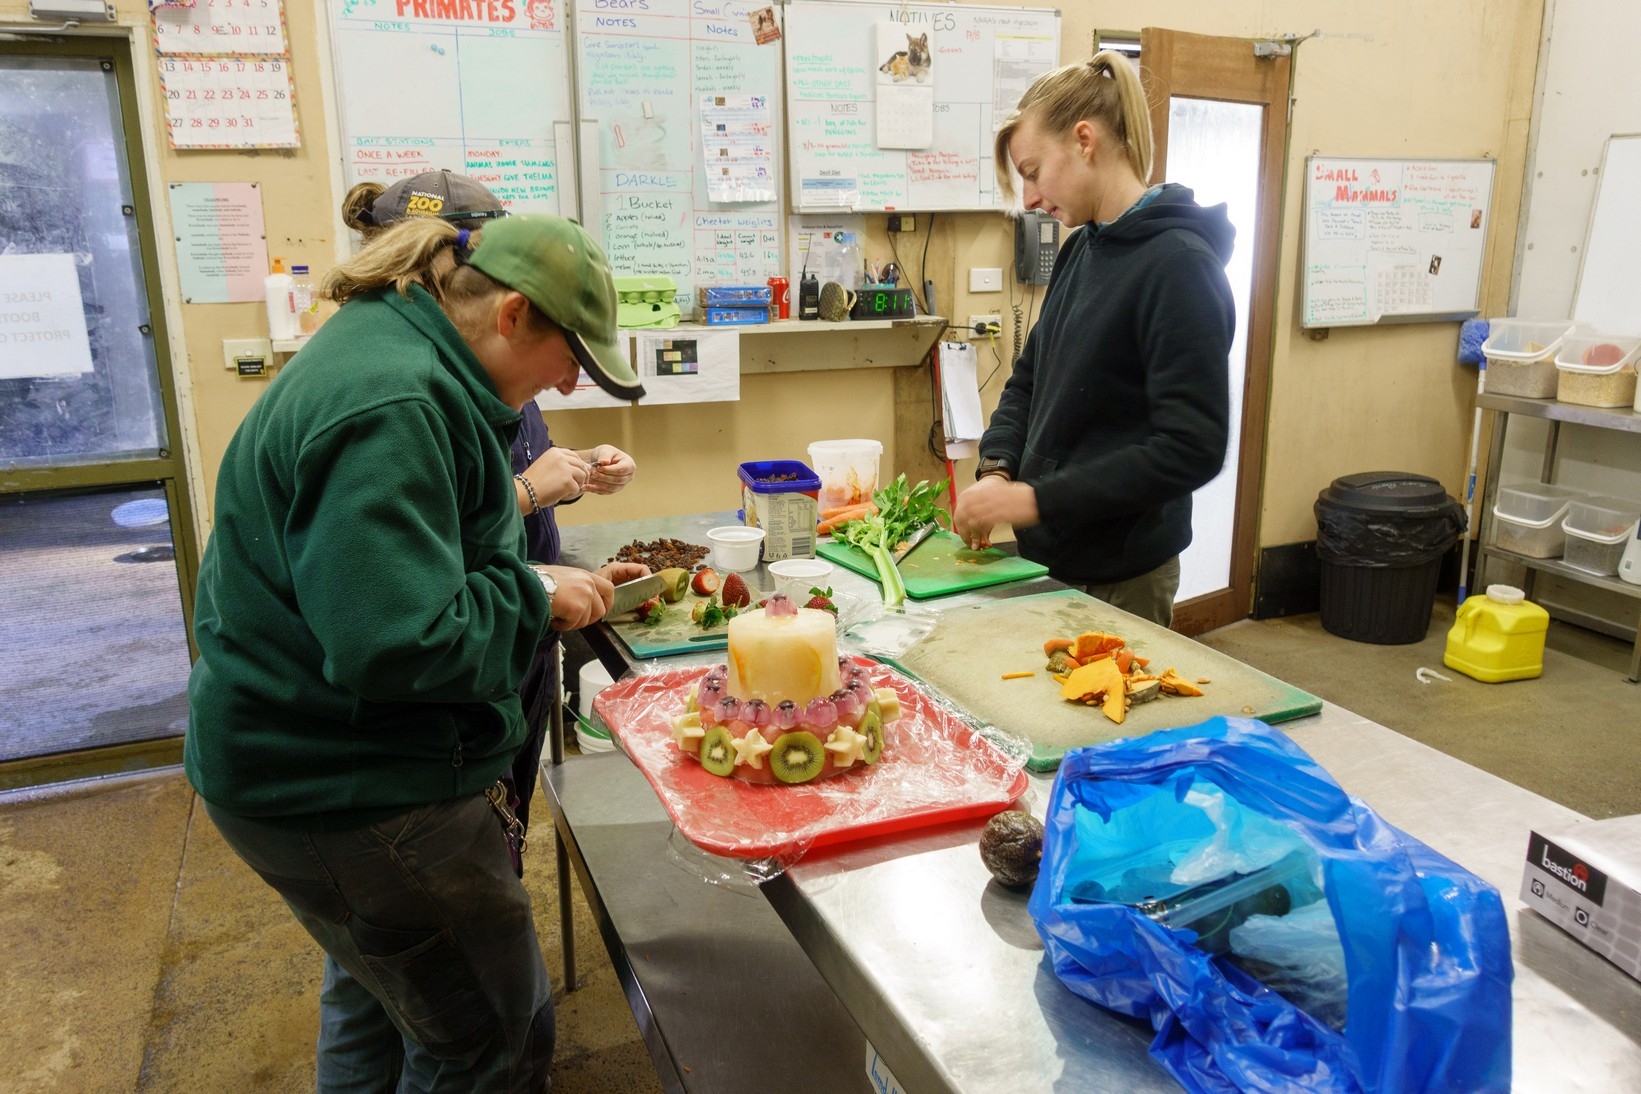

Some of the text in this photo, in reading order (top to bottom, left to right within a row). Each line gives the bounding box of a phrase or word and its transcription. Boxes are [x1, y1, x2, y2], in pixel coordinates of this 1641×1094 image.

[595, 0, 649, 10] Bears
[694, 1, 720, 15] Small
[395, 0, 516, 22] PRIMATES
[374, 22, 411, 32] NOTES
[596, 17, 637, 28] NOTES
[157, 24, 277, 36] 6 7 8 9 10 11 12
[489, 28, 516, 37] JOBS
[706, 24, 738, 37] Notes
[165, 62, 281, 73] 13 14 15 16 17 18 19
[168, 89, 286, 100] 20 21 22 23 24 25 26
[830, 102, 858, 113] NOTES
[172, 118, 254, 129] 27 28 29 30 31
[356, 150, 424, 160] ONCE A WEEK
[1315, 164, 1359, 182] SMALL
[615, 173, 678, 188] DARKLE
[411, 190, 445, 201] NATIONAL
[407, 195, 443, 213] ZOO
[628, 195, 673, 210] Bucket
[615, 233, 638, 242] orange
[875, 293, 910, 312] 8:11
[1541, 844, 1587, 892] bastion
